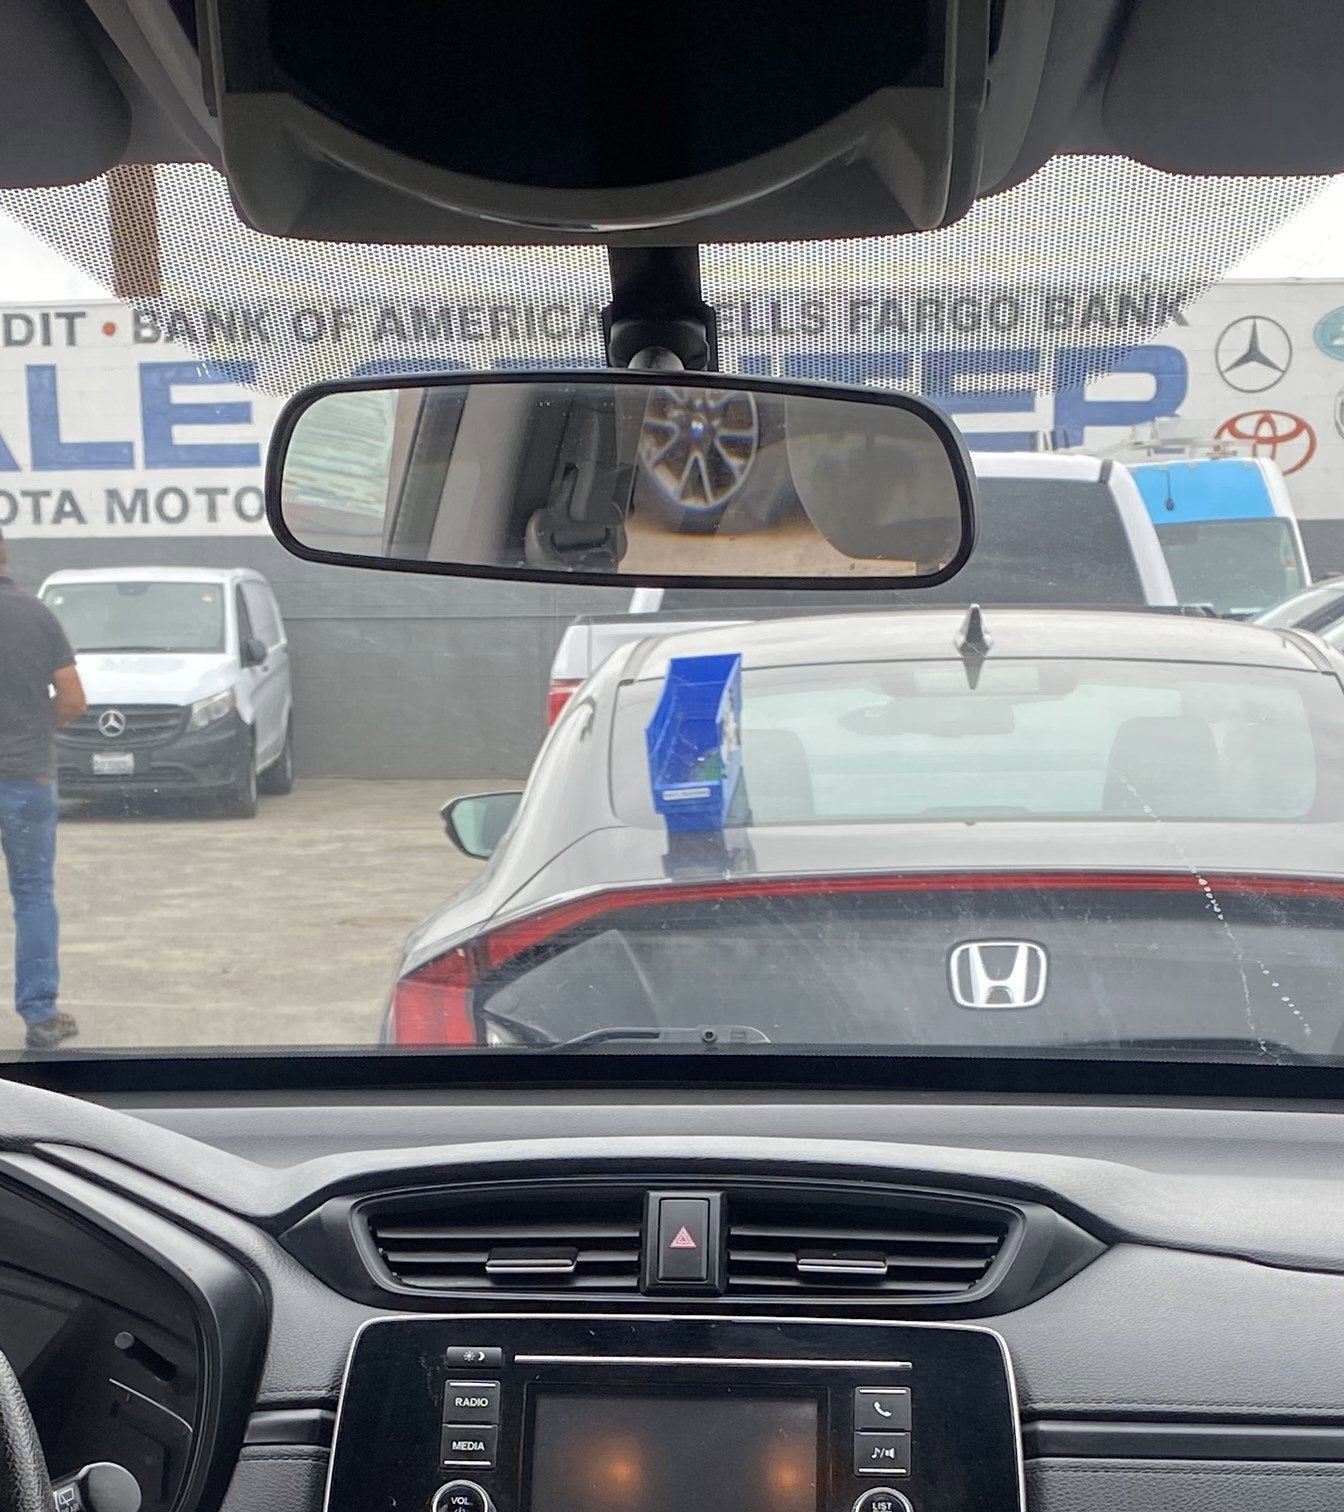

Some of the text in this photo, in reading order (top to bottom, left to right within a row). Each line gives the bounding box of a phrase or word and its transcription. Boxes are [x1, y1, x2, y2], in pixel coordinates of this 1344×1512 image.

[132, 307, 272, 346] BANK
[293, 305, 358, 343] OF
[715, 299, 826, 337] ELLS
[848, 296, 1020, 337] FARGO
[1044, 291, 1189, 332] BANK
[105, 485, 266, 524] MOTO
[454, 1397, 489, 1407] RADIO
[451, 1441, 485, 1451] MEDIA
[450, 1497, 470, 1505] VOL
[872, 1502, 893, 1510] LIST
